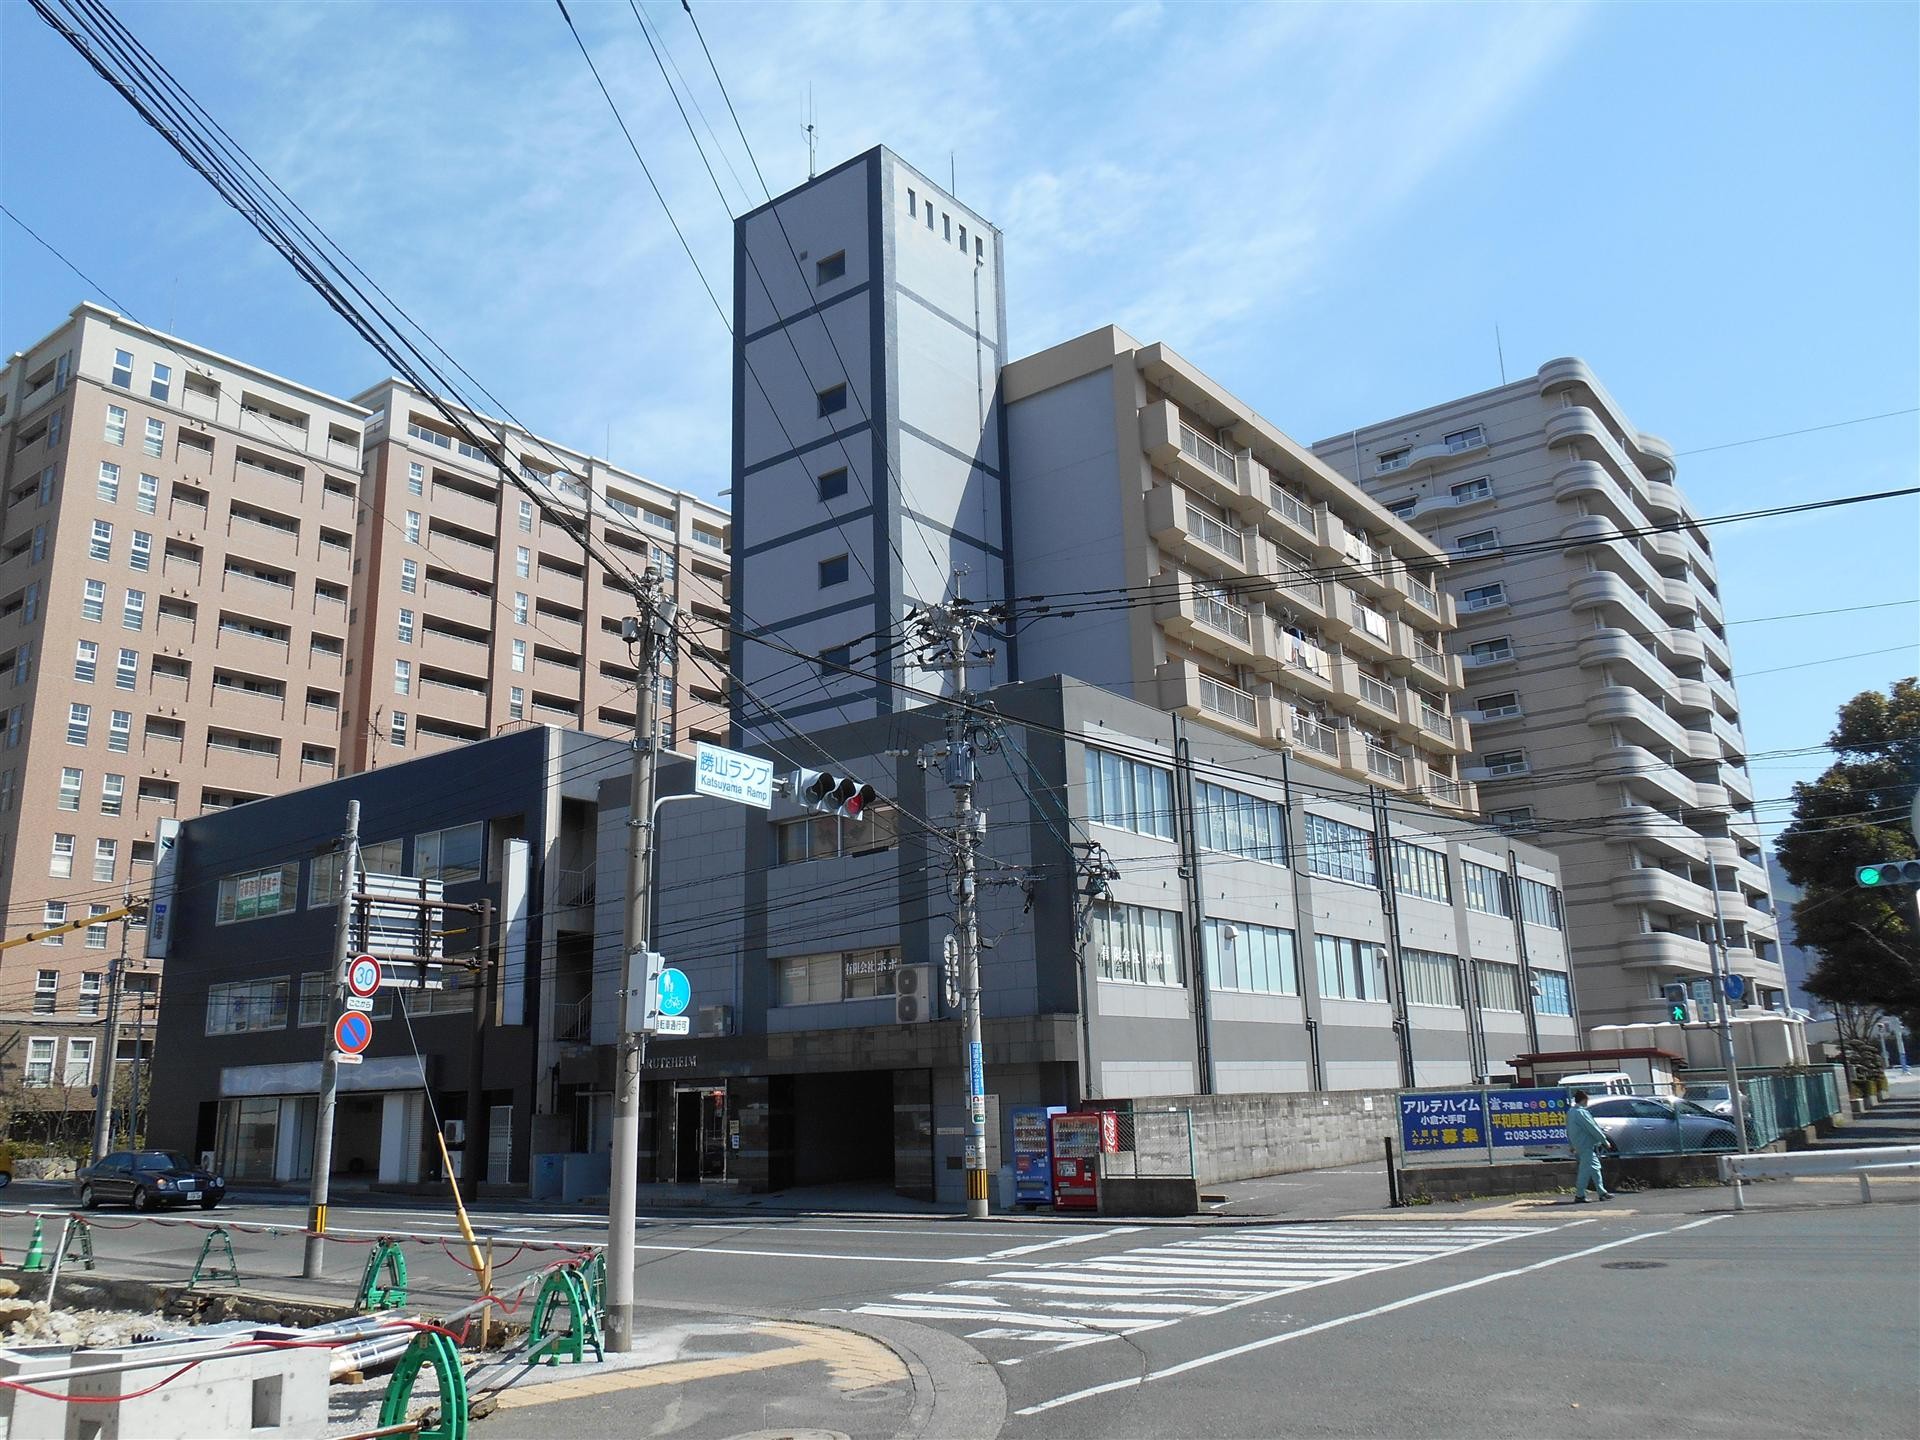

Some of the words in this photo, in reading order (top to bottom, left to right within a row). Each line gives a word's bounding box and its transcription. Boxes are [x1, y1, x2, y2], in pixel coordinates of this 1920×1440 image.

[700, 751, 770, 785] 勝山ランプ
[701, 774, 743, 794] Katsuyama
[747, 785, 767, 801] Ramp
[355, 966, 374, 986] 30
[348, 999, 371, 1009] ここから
[1403, 1098, 1480, 1114] アルテハイム
[1420, 1114, 1467, 1125] 小倉大手町
[1411, 1137, 1440, 1146] テナント
